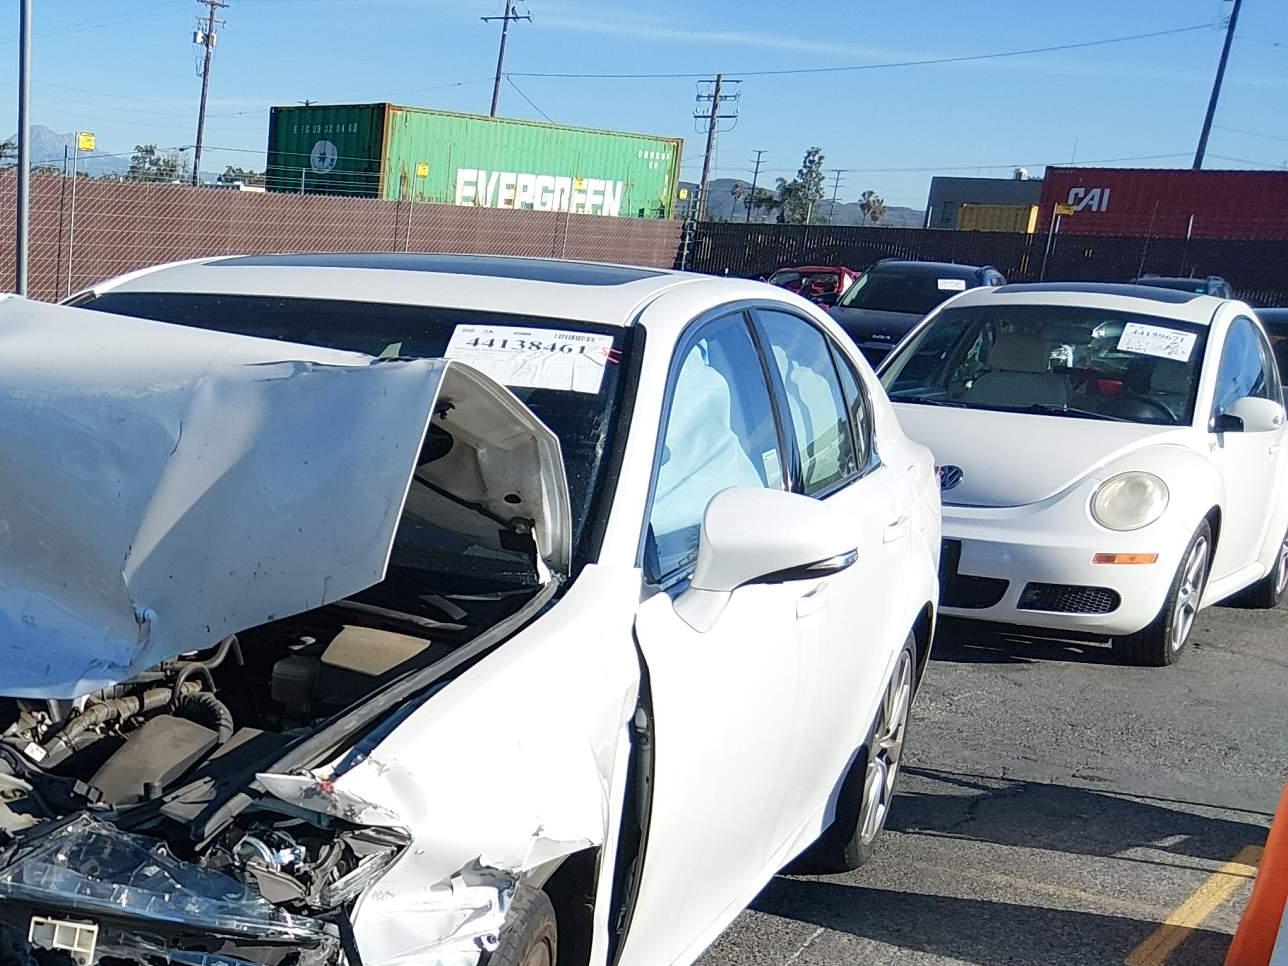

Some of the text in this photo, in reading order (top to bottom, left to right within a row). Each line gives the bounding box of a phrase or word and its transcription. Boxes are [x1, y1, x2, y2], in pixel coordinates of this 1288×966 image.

[455, 168, 624, 216] EVERGREEN
[1067, 187, 1111, 211] CAI
[465, 336, 587, 354] 44138461
